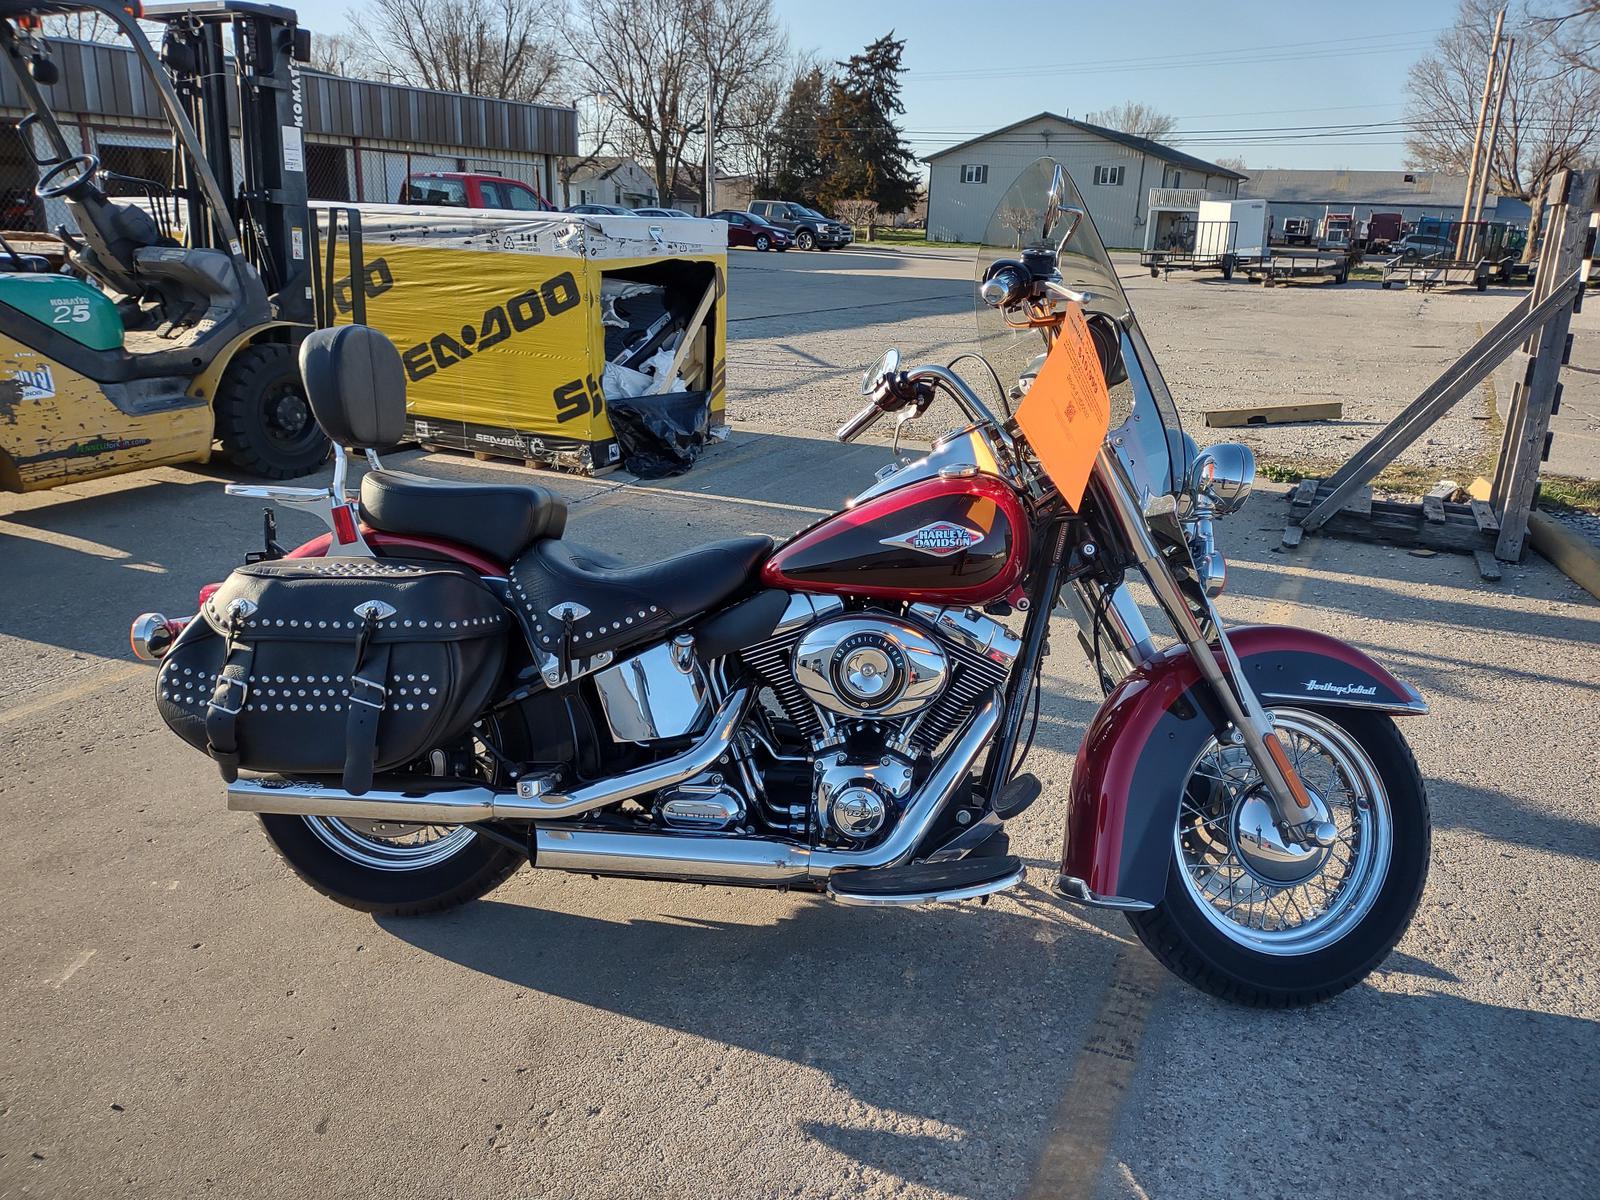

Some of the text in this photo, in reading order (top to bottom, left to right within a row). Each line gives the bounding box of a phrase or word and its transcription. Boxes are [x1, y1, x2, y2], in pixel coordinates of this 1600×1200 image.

[53, 305, 91, 323] 25
[914, 538, 970, 548] DAVIDSON
[845, 636, 873, 648] CUBIC
[877, 638, 903, 667] INCHES
